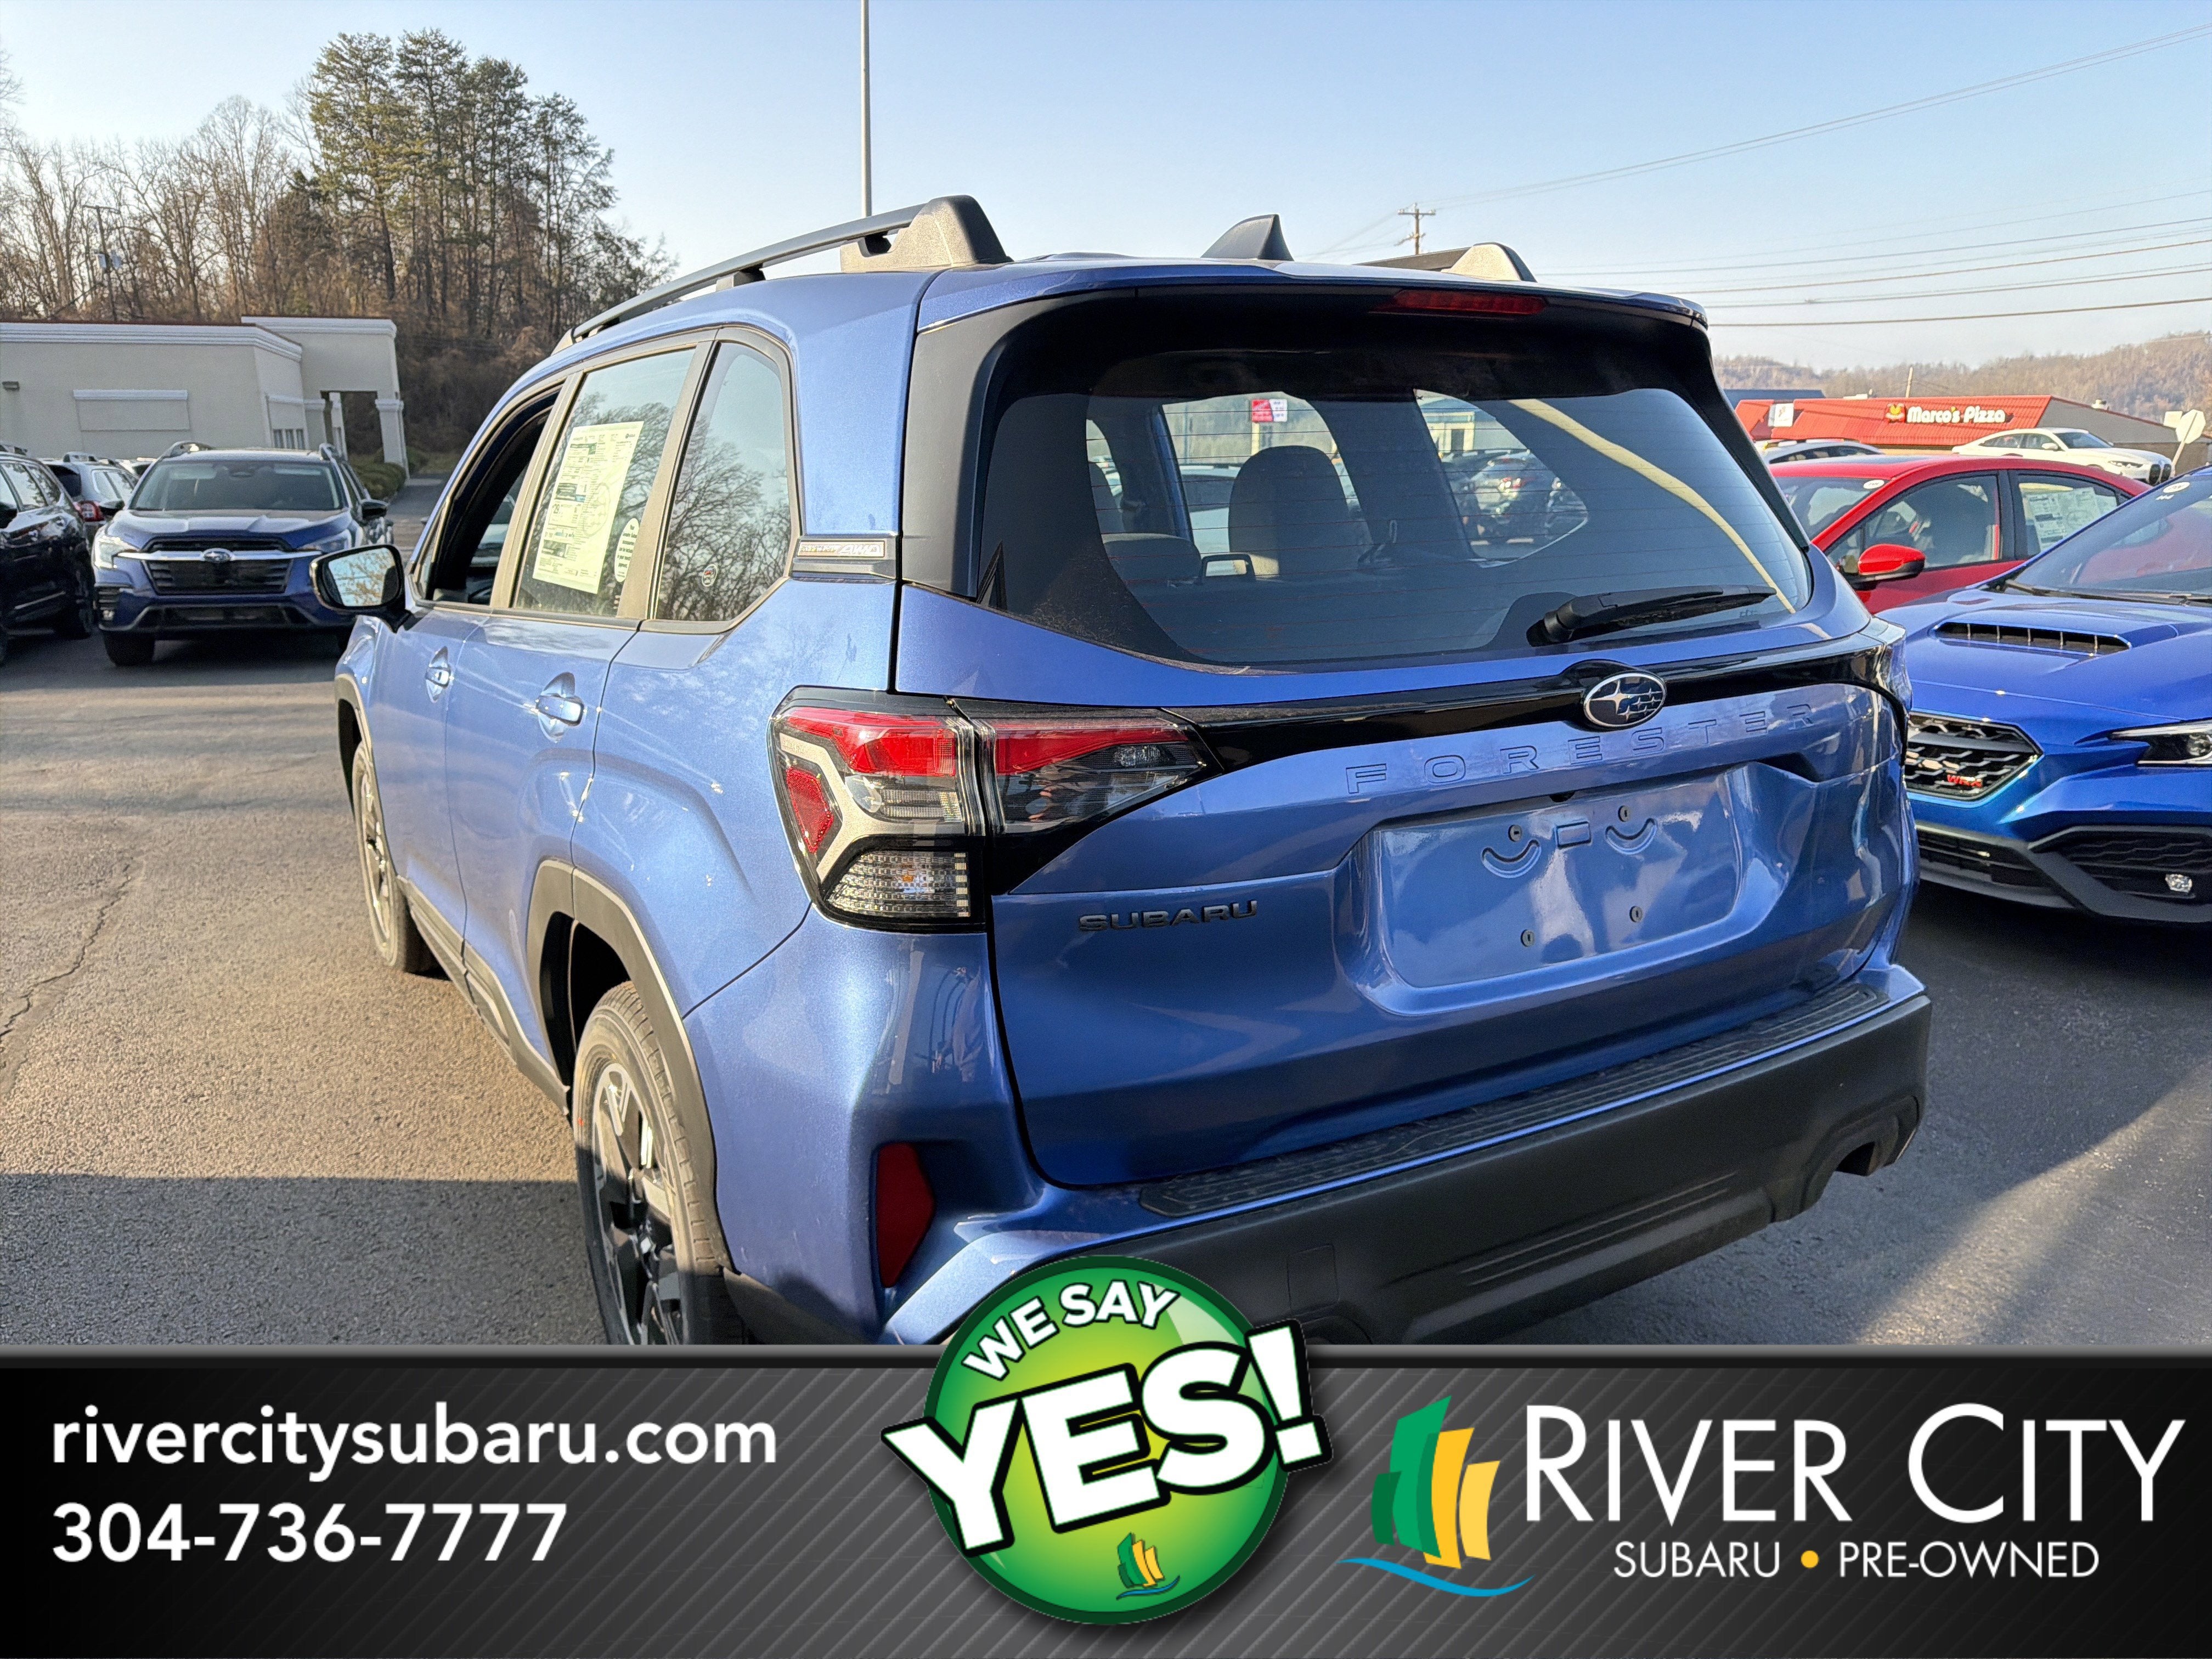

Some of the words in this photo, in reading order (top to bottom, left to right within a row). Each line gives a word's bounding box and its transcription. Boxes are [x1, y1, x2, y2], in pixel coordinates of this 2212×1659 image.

[1906, 406, 1961, 424] Marco's
[1963, 405, 2006, 423] Pizza
[1345, 703, 1815, 794] FORESTER
[1947, 774, 1983, 788] WRX
[1079, 900, 1257, 932] SUBARU
